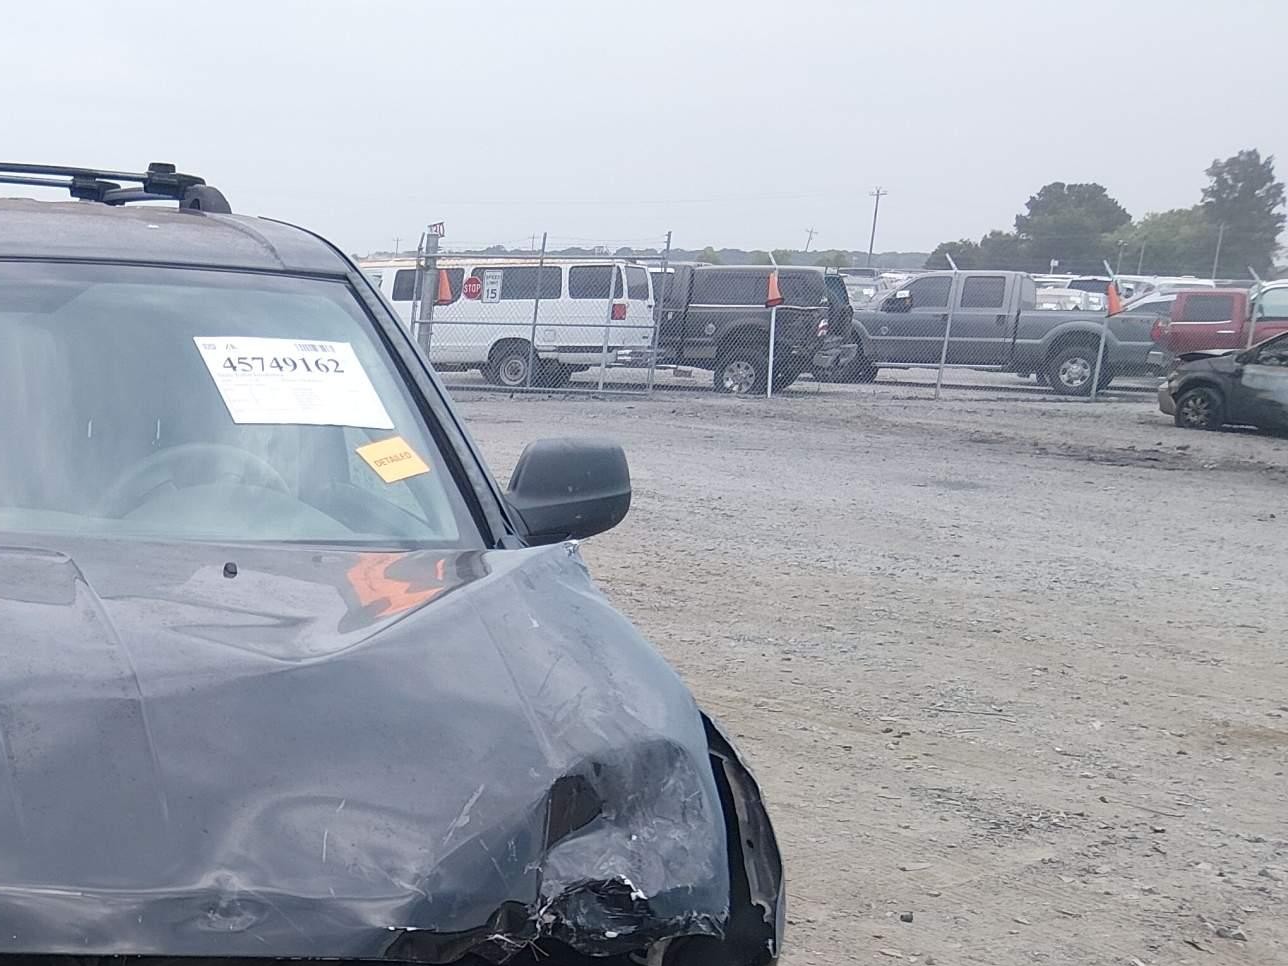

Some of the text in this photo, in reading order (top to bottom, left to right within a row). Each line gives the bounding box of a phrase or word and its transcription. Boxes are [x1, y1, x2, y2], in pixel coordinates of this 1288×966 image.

[463, 283, 481, 293] STOP
[486, 288, 497, 299] 15
[223, 356, 345, 373] 45749162
